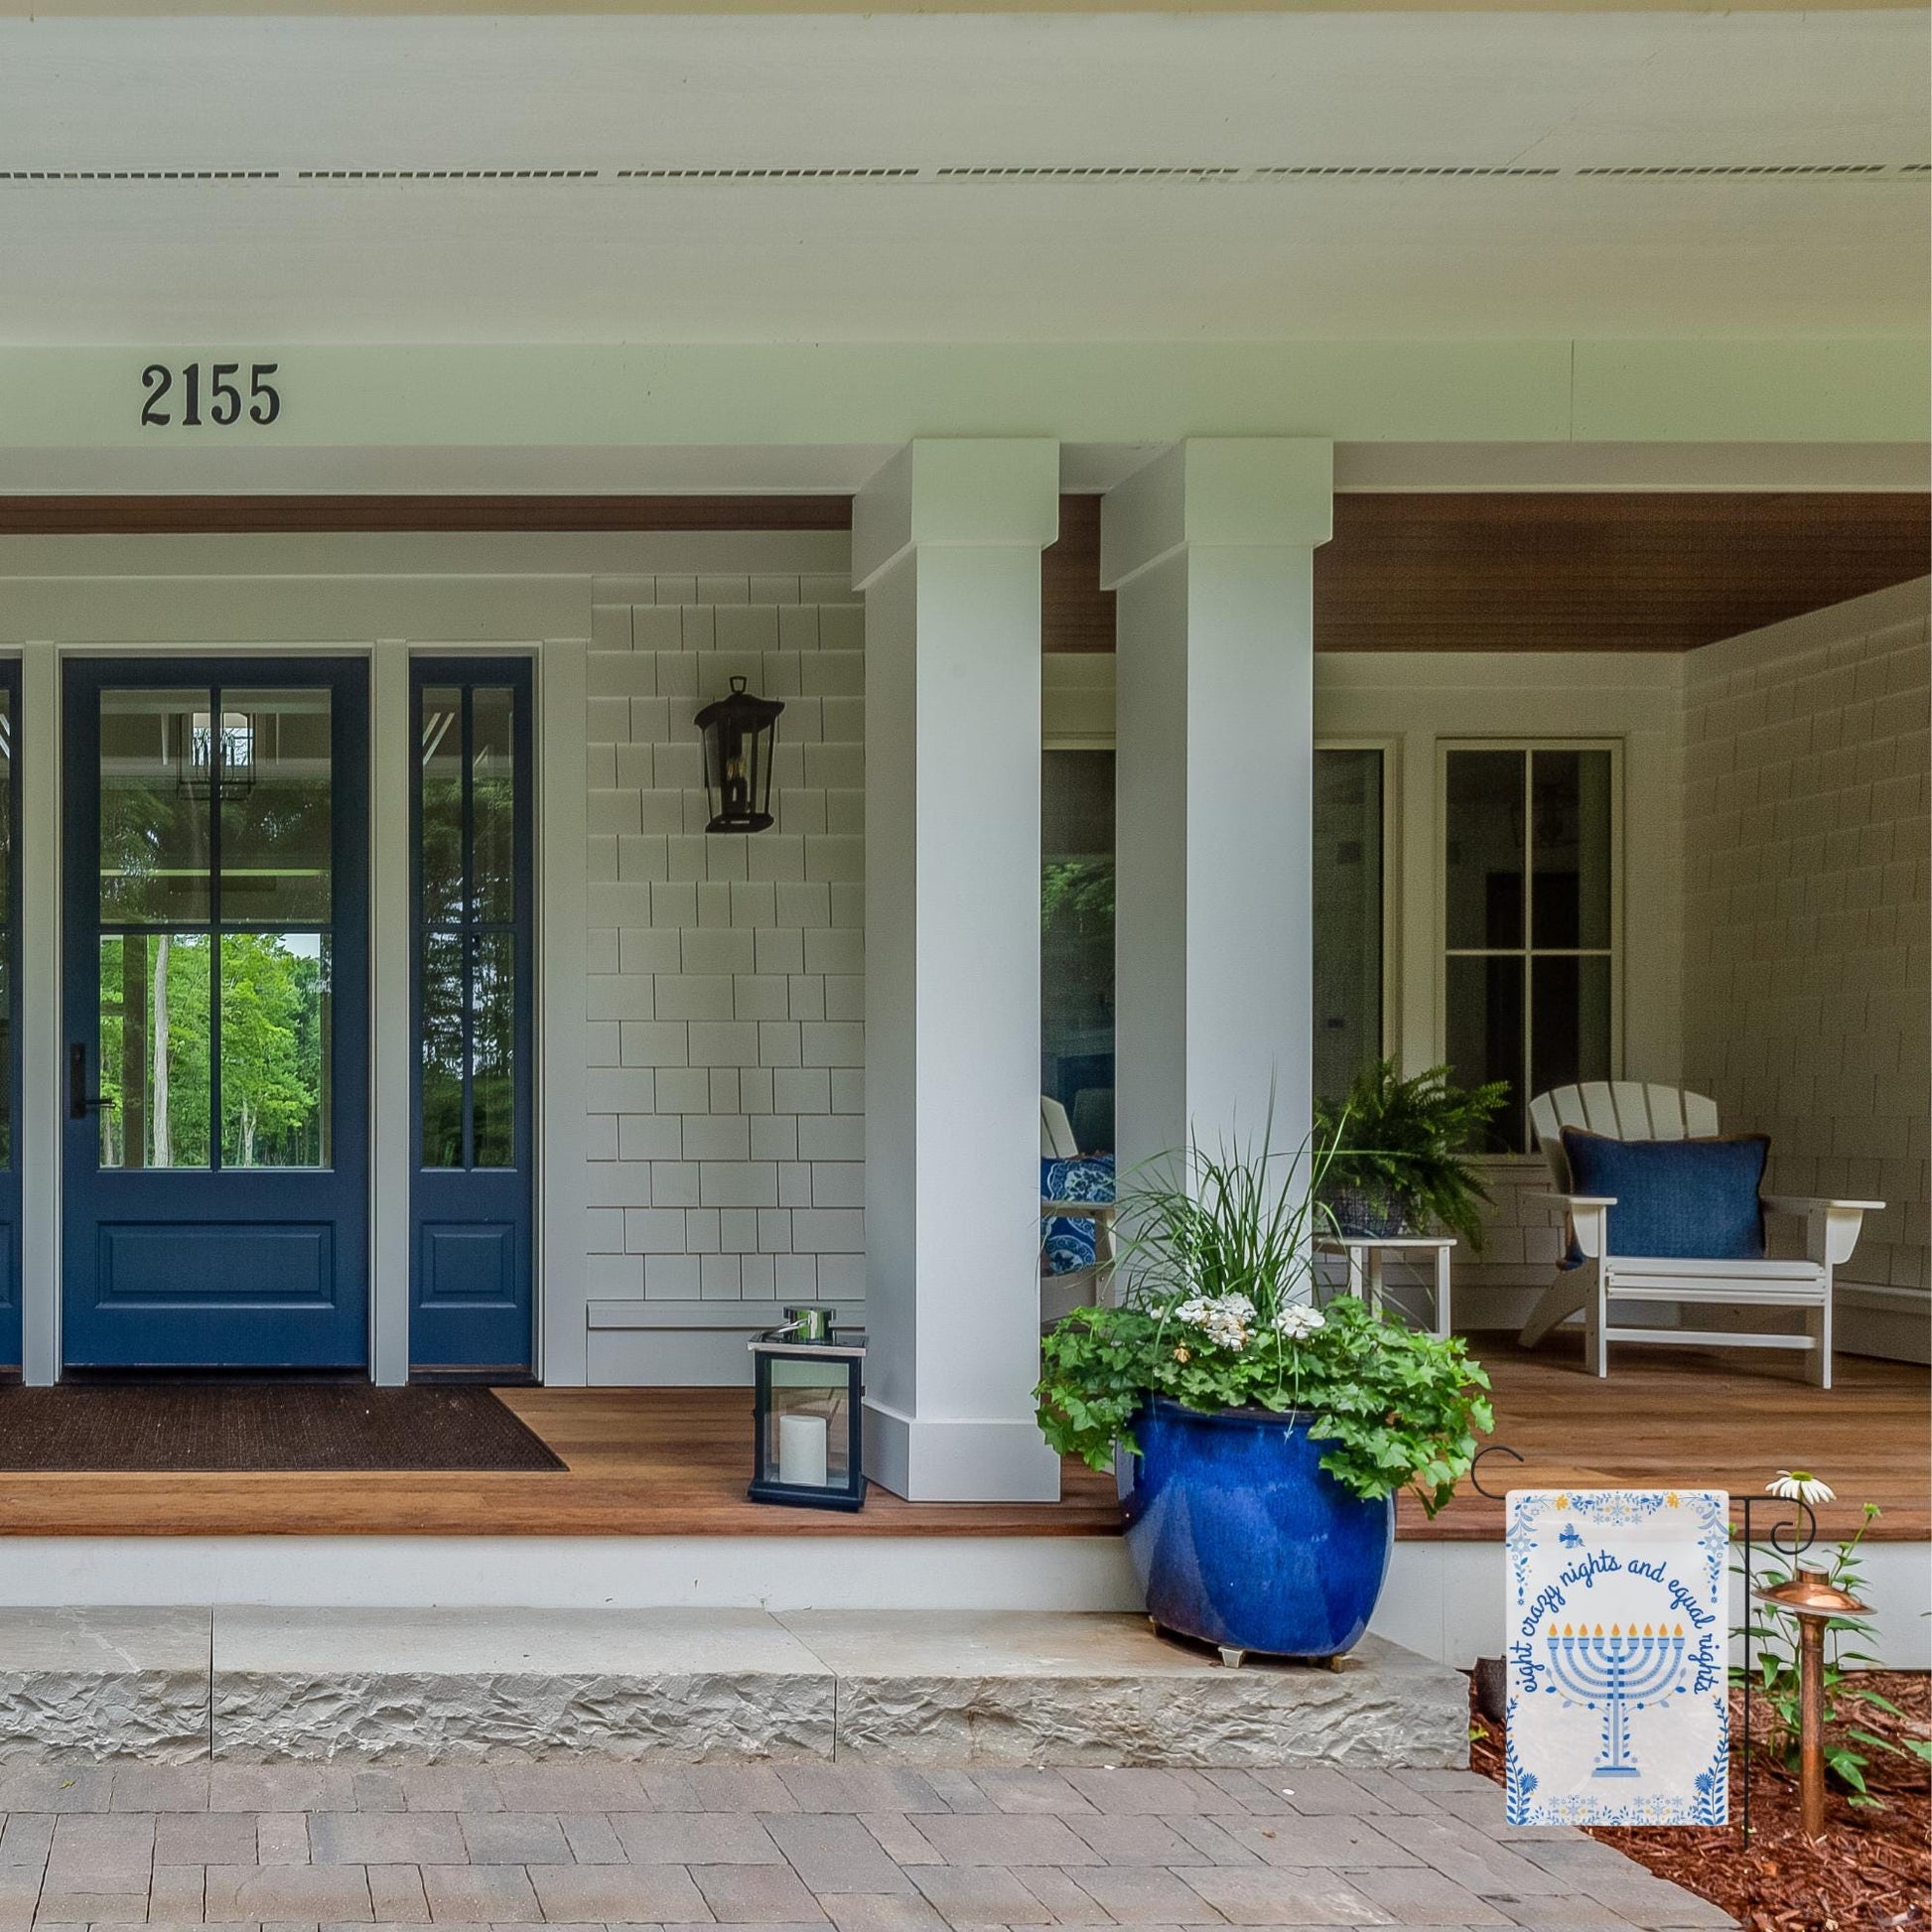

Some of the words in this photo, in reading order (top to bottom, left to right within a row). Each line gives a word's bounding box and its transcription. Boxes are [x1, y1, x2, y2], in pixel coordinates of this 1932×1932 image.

[141, 362, 280, 426] 2155
[1559, 1549, 1622, 1588] nights
[1627, 1559, 1667, 1584] and
[1521, 1585, 1566, 1637] crazy
[1668, 1579, 1717, 1629] equal
[1509, 1640, 1545, 1693] eight
[1688, 1633, 1722, 1695] rights
